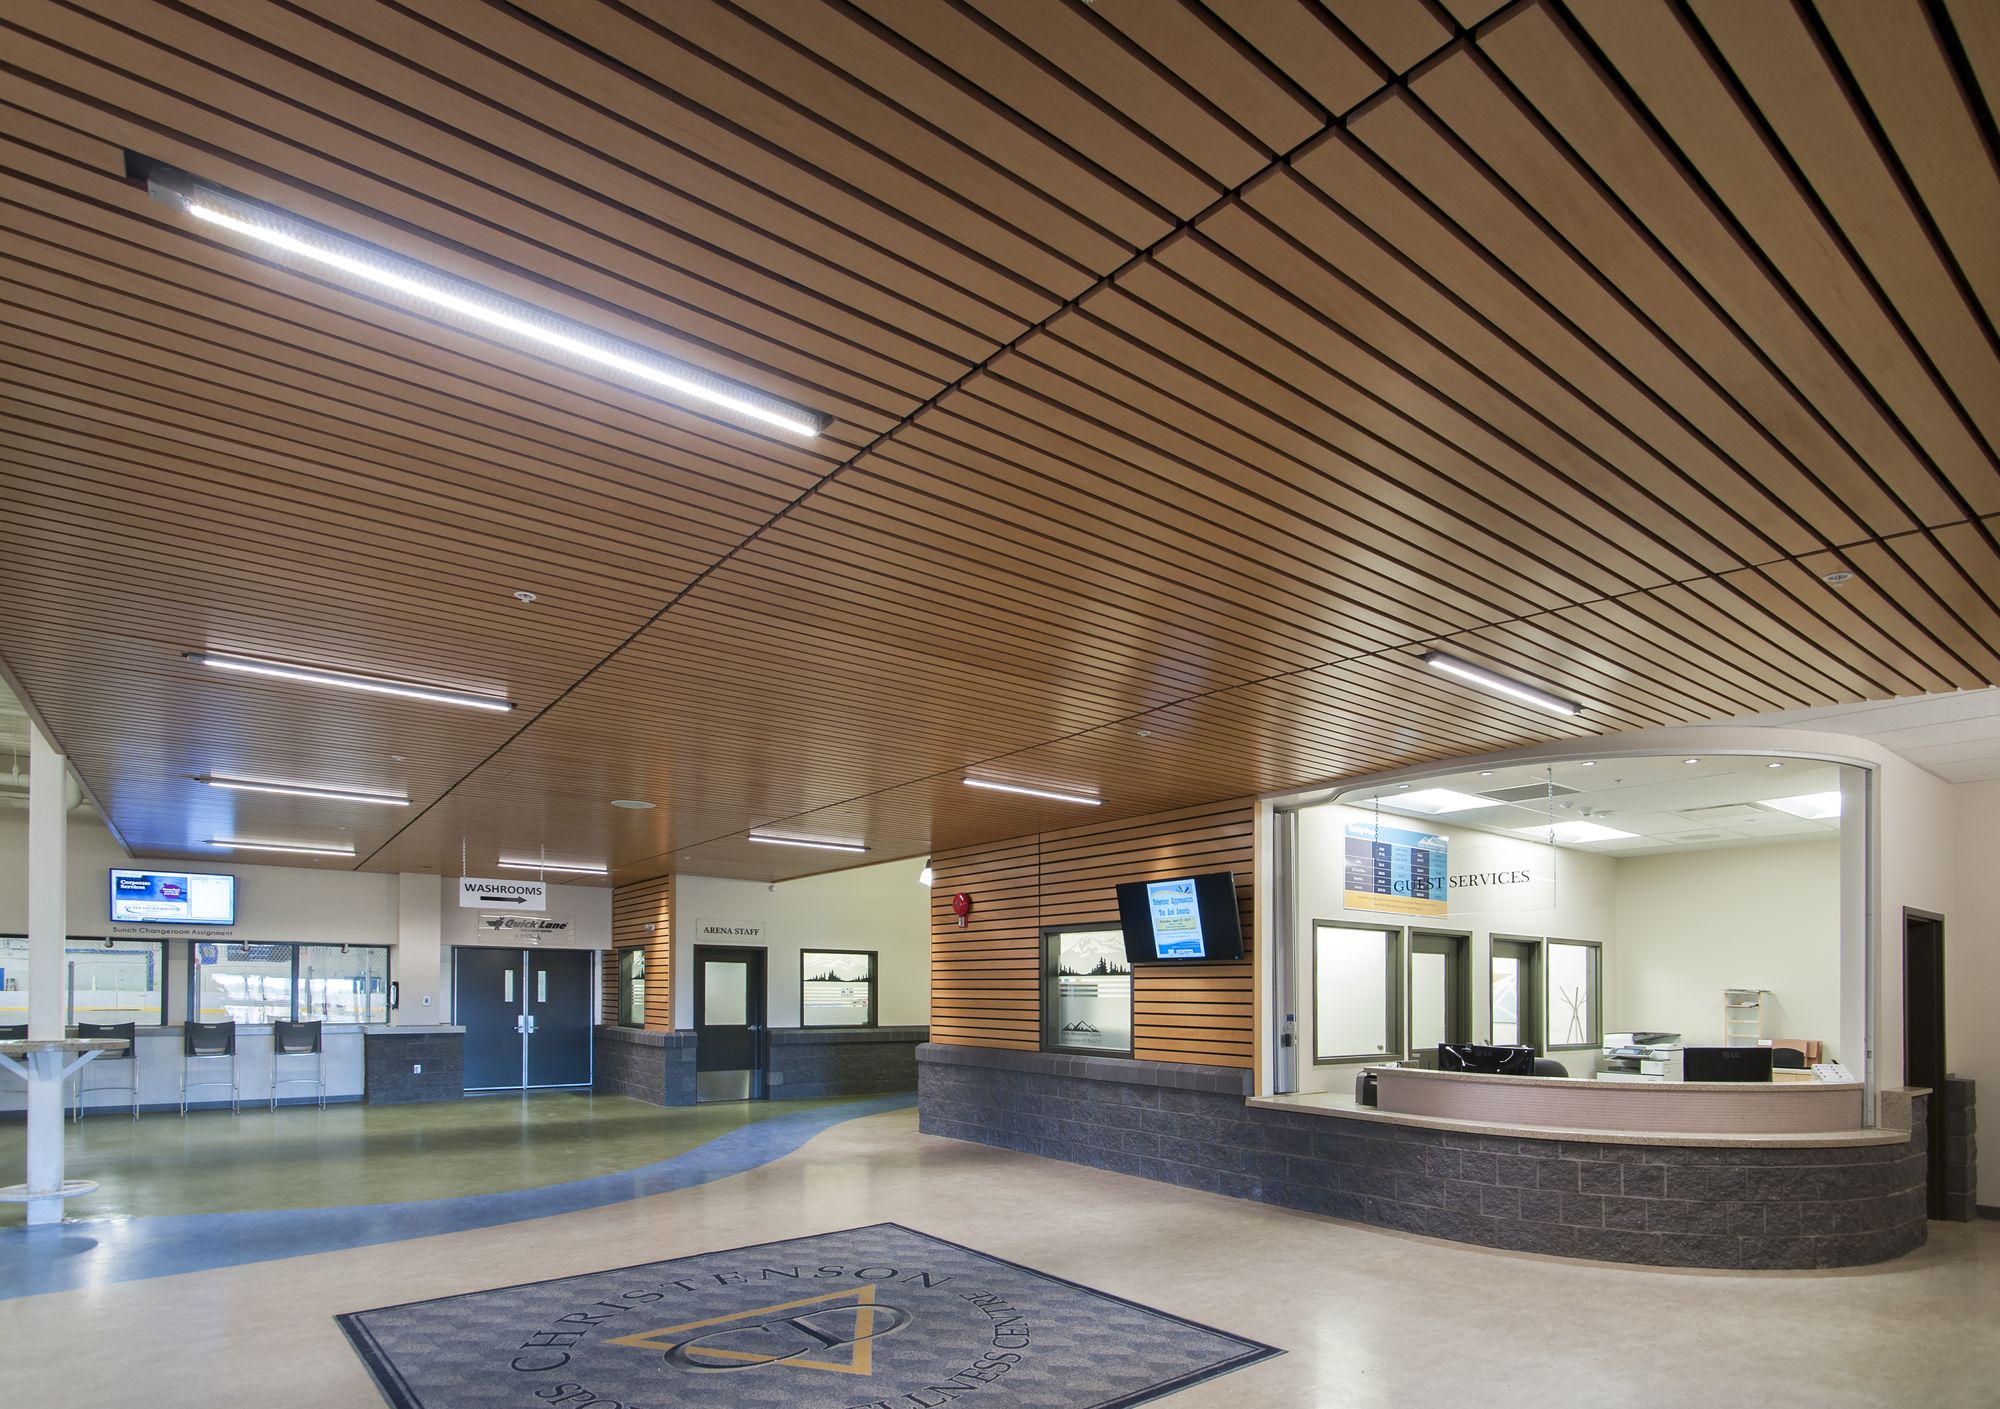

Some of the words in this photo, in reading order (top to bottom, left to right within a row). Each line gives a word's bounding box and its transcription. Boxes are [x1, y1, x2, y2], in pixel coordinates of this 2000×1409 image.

[1393, 876, 1445, 892] GUEST
[1449, 869, 1531, 888] SERVICES
[464, 883, 543, 896] WASHROOMS
[505, 919, 539, 929] Quick
[538, 920, 567, 930] Lane
[703, 926, 733, 935] ARENA
[734, 927, 760, 936] STAFF
[113, 926, 137, 934] Bunch
[139, 927, 190, 936] Changeroom
[192, 929, 233, 937] Assignment
[511, 1265, 956, 1372] CHRISTENSON
[959, 1289, 1031, 1349] CENTRE
